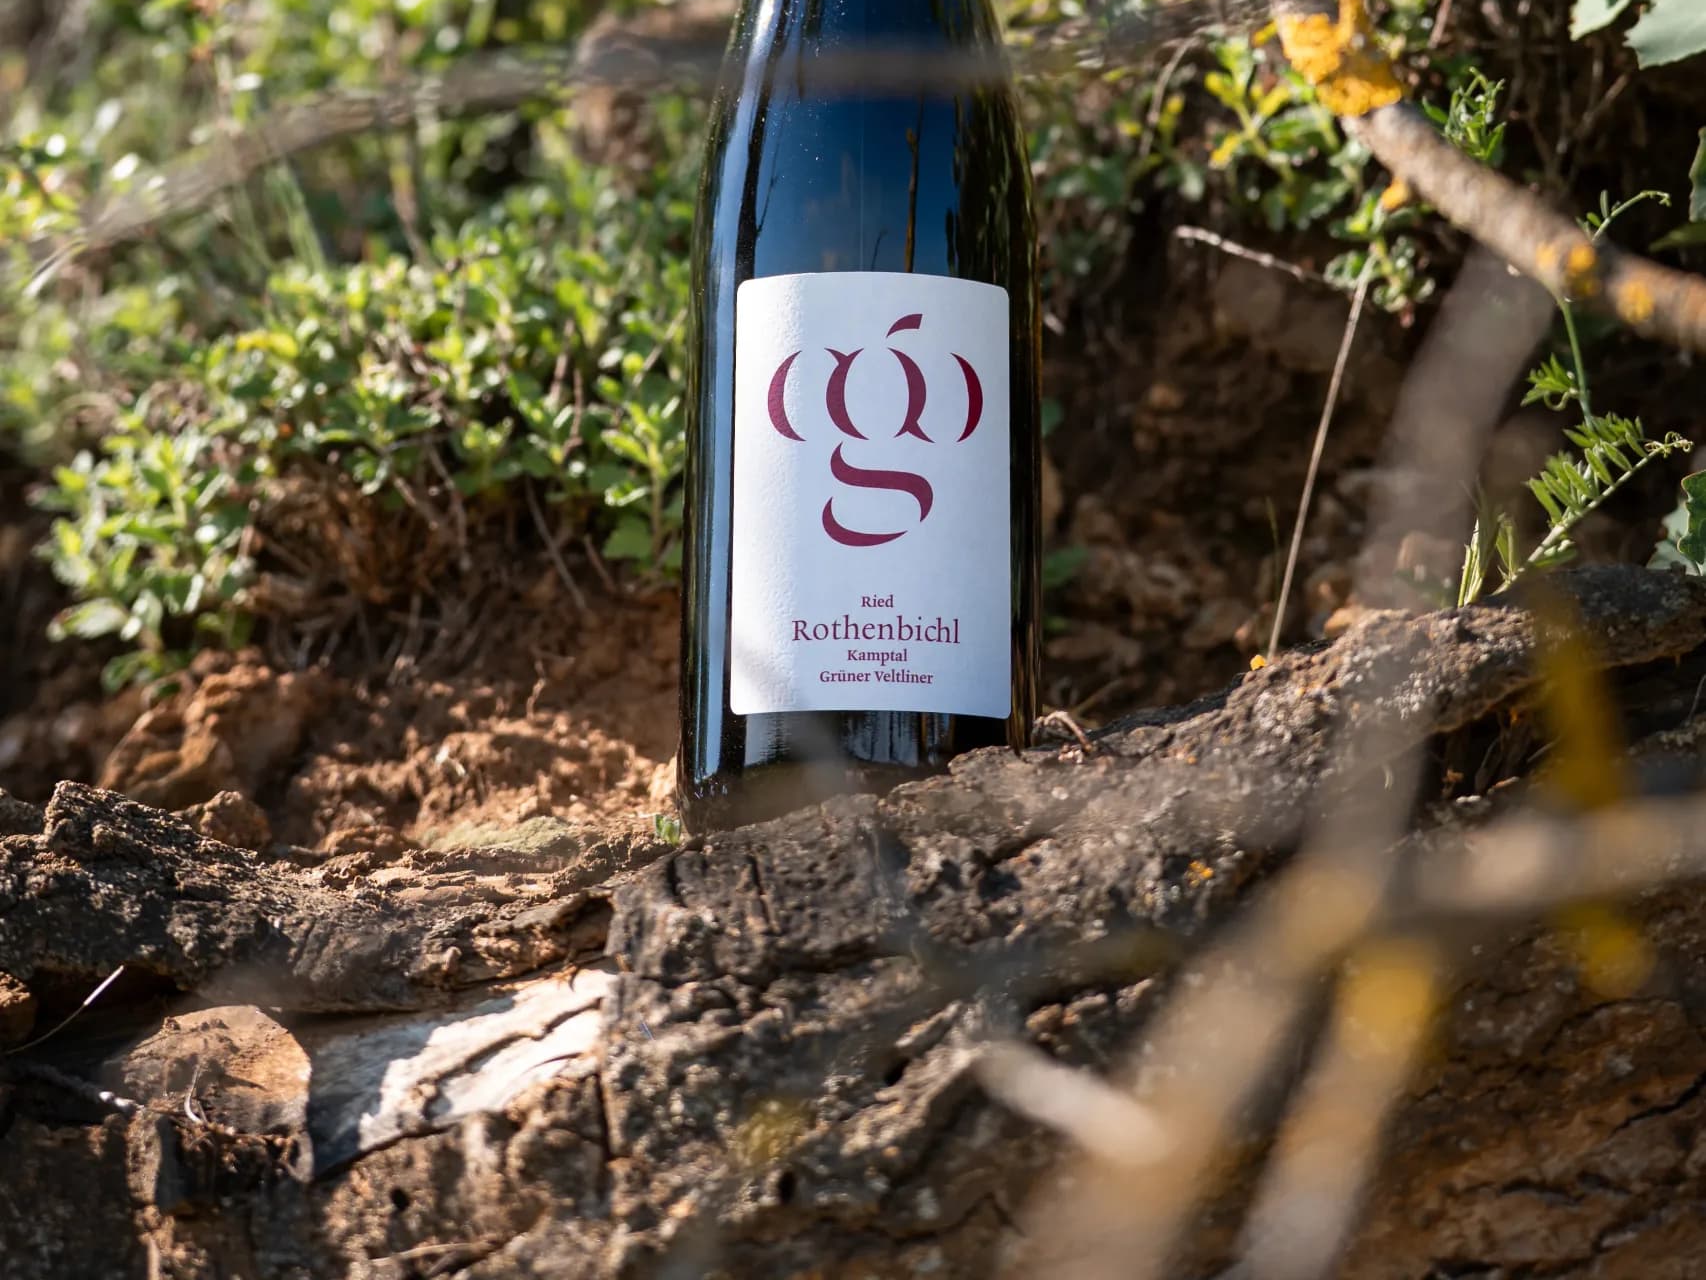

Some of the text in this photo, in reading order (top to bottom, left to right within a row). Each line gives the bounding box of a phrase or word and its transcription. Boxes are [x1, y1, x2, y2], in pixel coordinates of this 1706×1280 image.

[861, 594, 894, 608] Ried
[791, 614, 961, 644] Rothenbichl
[847, 648, 908, 666] Kamptal
[819, 669, 934, 684] Grüner Veltliner
